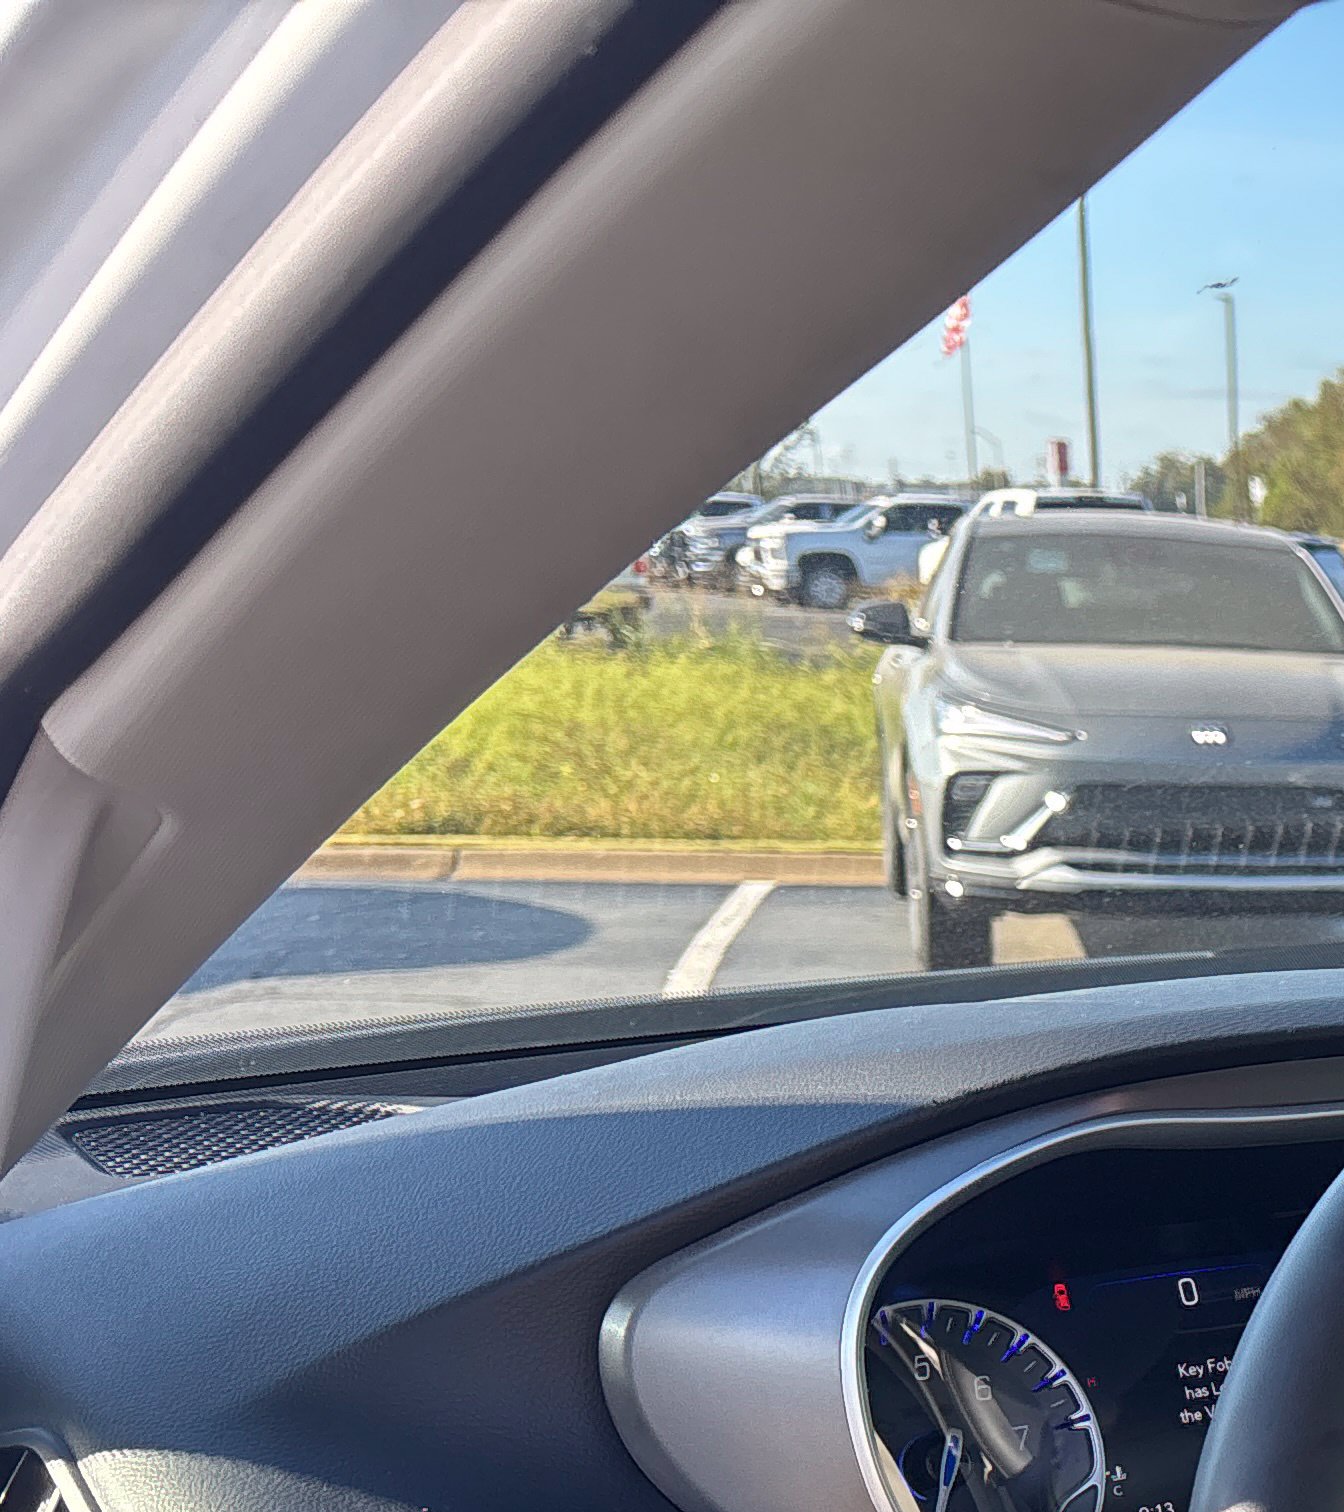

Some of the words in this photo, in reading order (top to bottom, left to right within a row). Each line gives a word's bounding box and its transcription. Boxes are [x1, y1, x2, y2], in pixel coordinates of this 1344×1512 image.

[1177, 1277, 1199, 1306] 0
[913, 1354, 931, 1381] 5
[1177, 1362, 1204, 1379] Key
[974, 1375, 993, 1401] 6
[1184, 1385, 1210, 1400] has
[1179, 1408, 1203, 1424] the
[1012, 1424, 1029, 1450] 7
[1113, 1484, 1124, 1497] C
